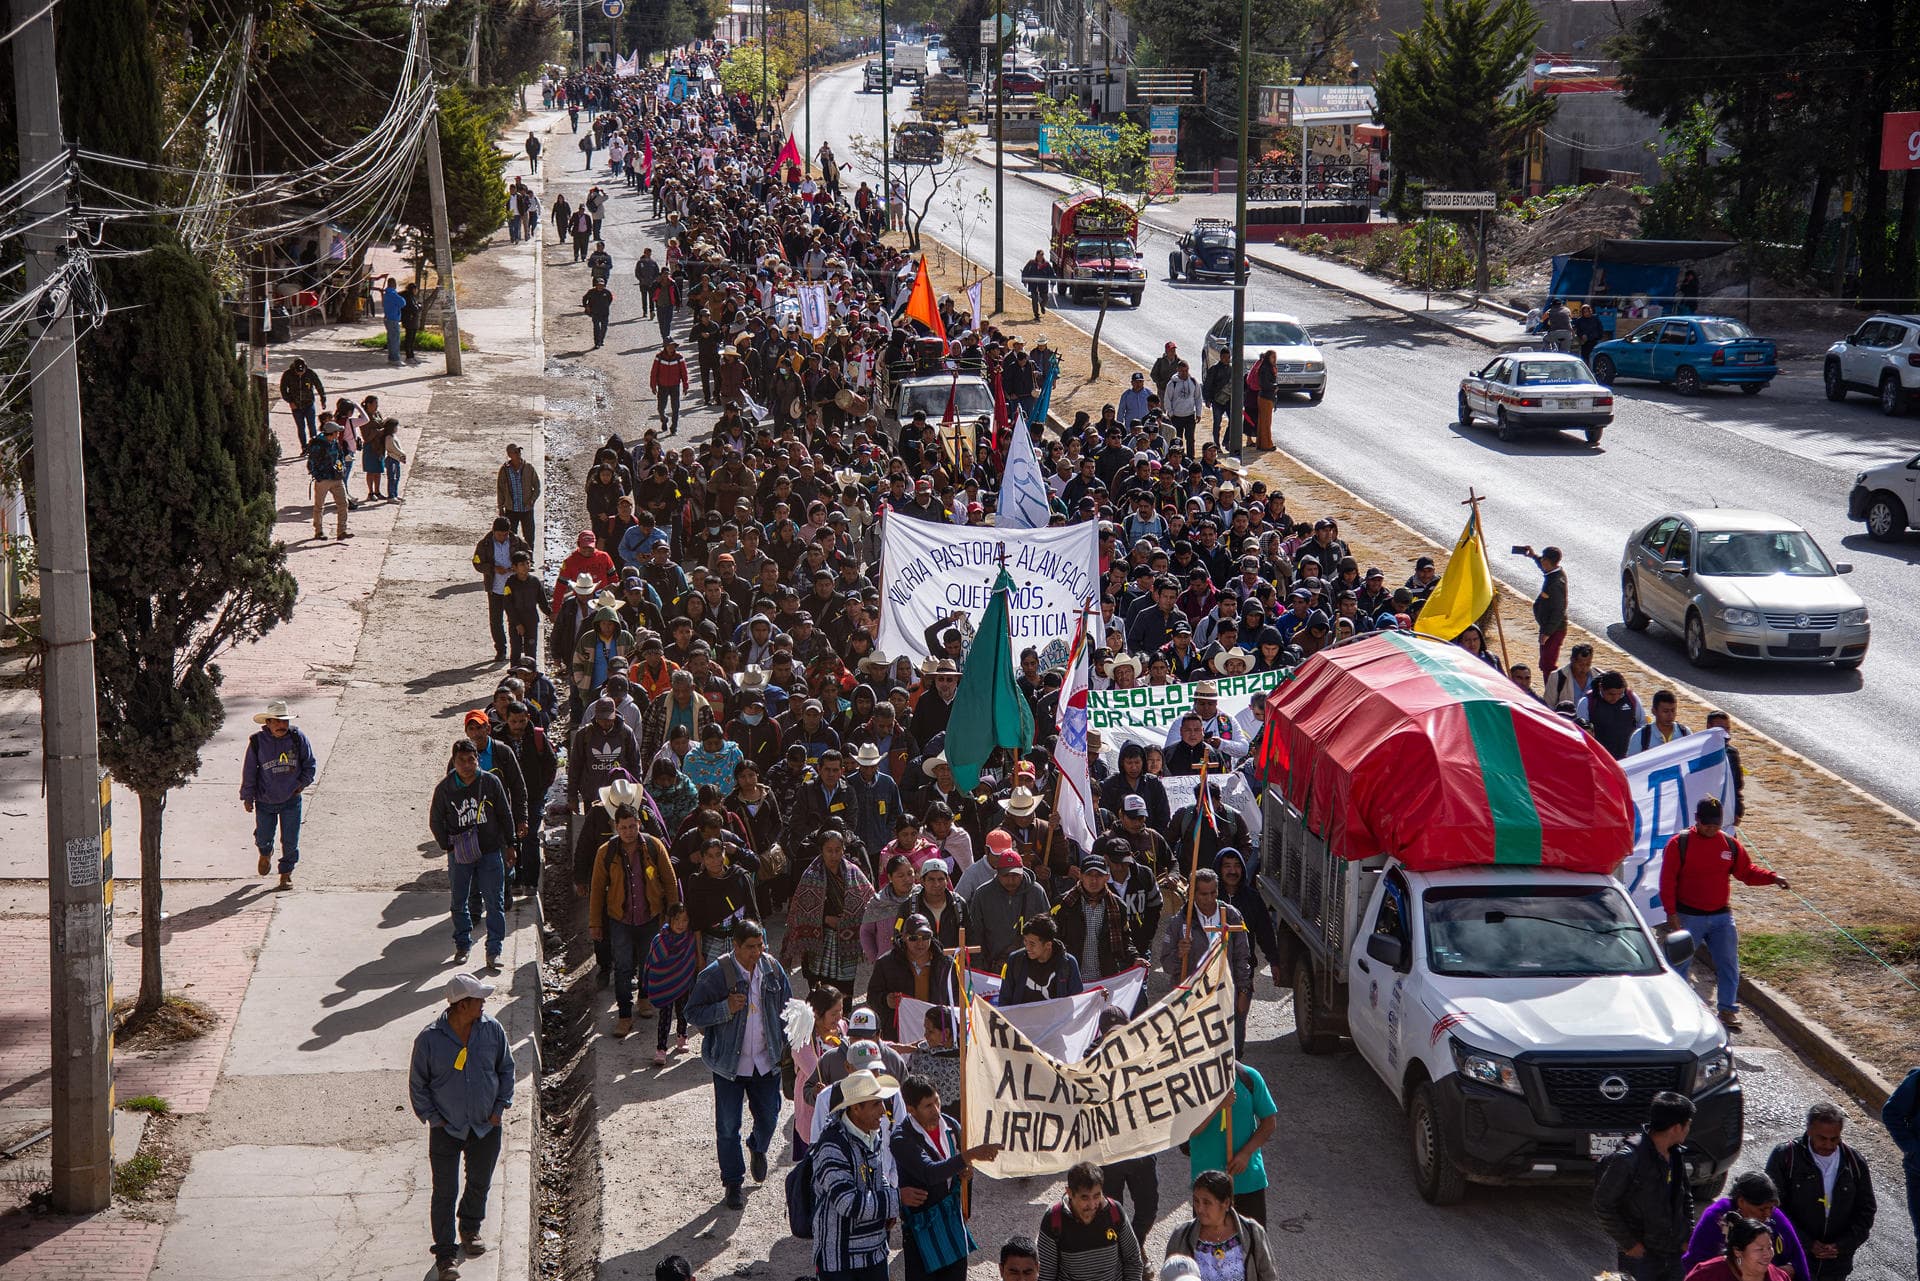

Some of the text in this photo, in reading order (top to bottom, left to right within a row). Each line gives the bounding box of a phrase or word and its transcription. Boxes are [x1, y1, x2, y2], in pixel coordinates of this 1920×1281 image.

[1054, 73, 1120, 85] HOTEL
[978, 111, 1042, 121] HOTE
[1424, 194, 1495, 206] PROHIBIDO ESTACIONARSE
[1010, 612, 1068, 638] USTICIA
[1112, 684, 1182, 709] SOLO
[1126, 709, 1157, 727] LA
[592, 762, 620, 770] adid
